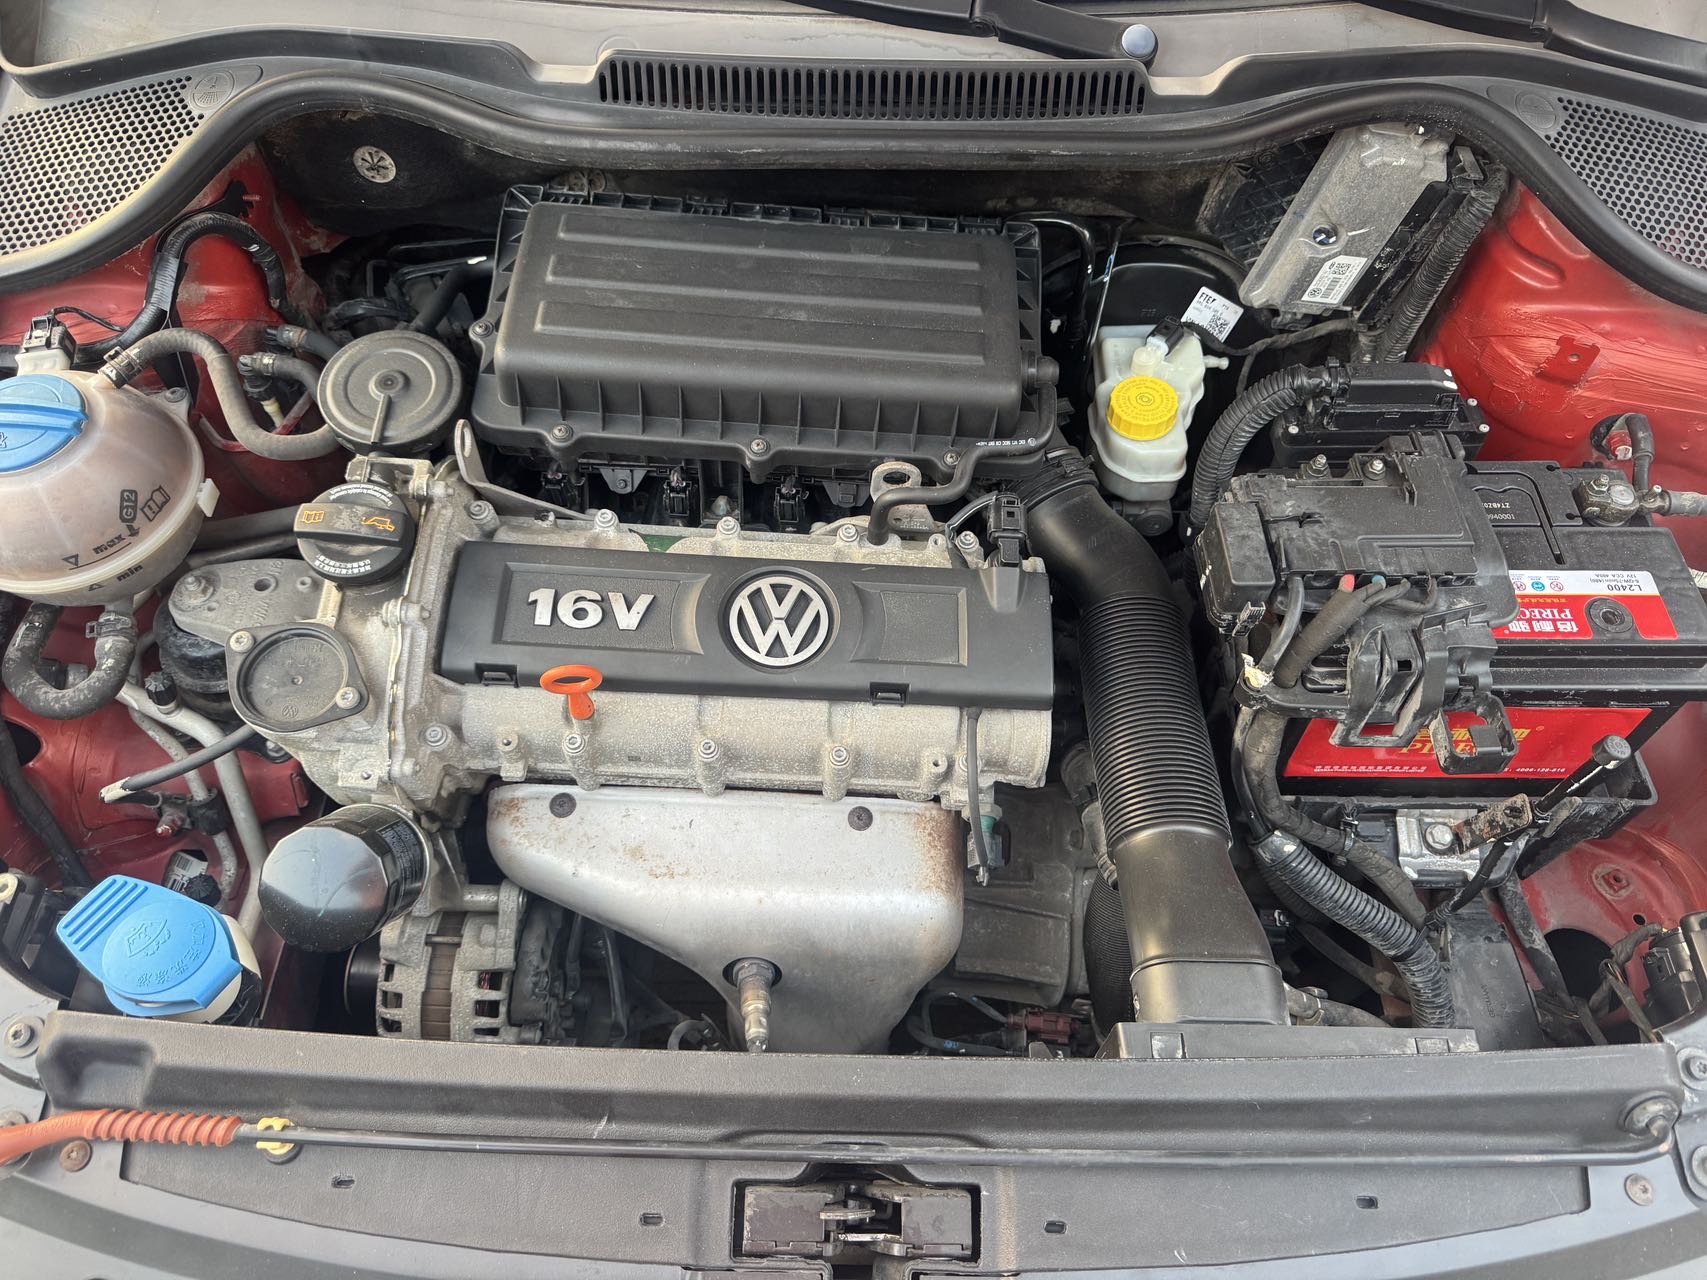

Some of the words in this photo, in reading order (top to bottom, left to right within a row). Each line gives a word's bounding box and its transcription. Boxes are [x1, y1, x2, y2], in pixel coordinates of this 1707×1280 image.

[122, 491, 136, 519] G12
[93, 534, 126, 554] max
[116, 565, 143, 582] min
[1606, 583, 1643, 592] L2400
[527, 588, 655, 631] 16V
[1516, 607, 1573, 620] PIREC
